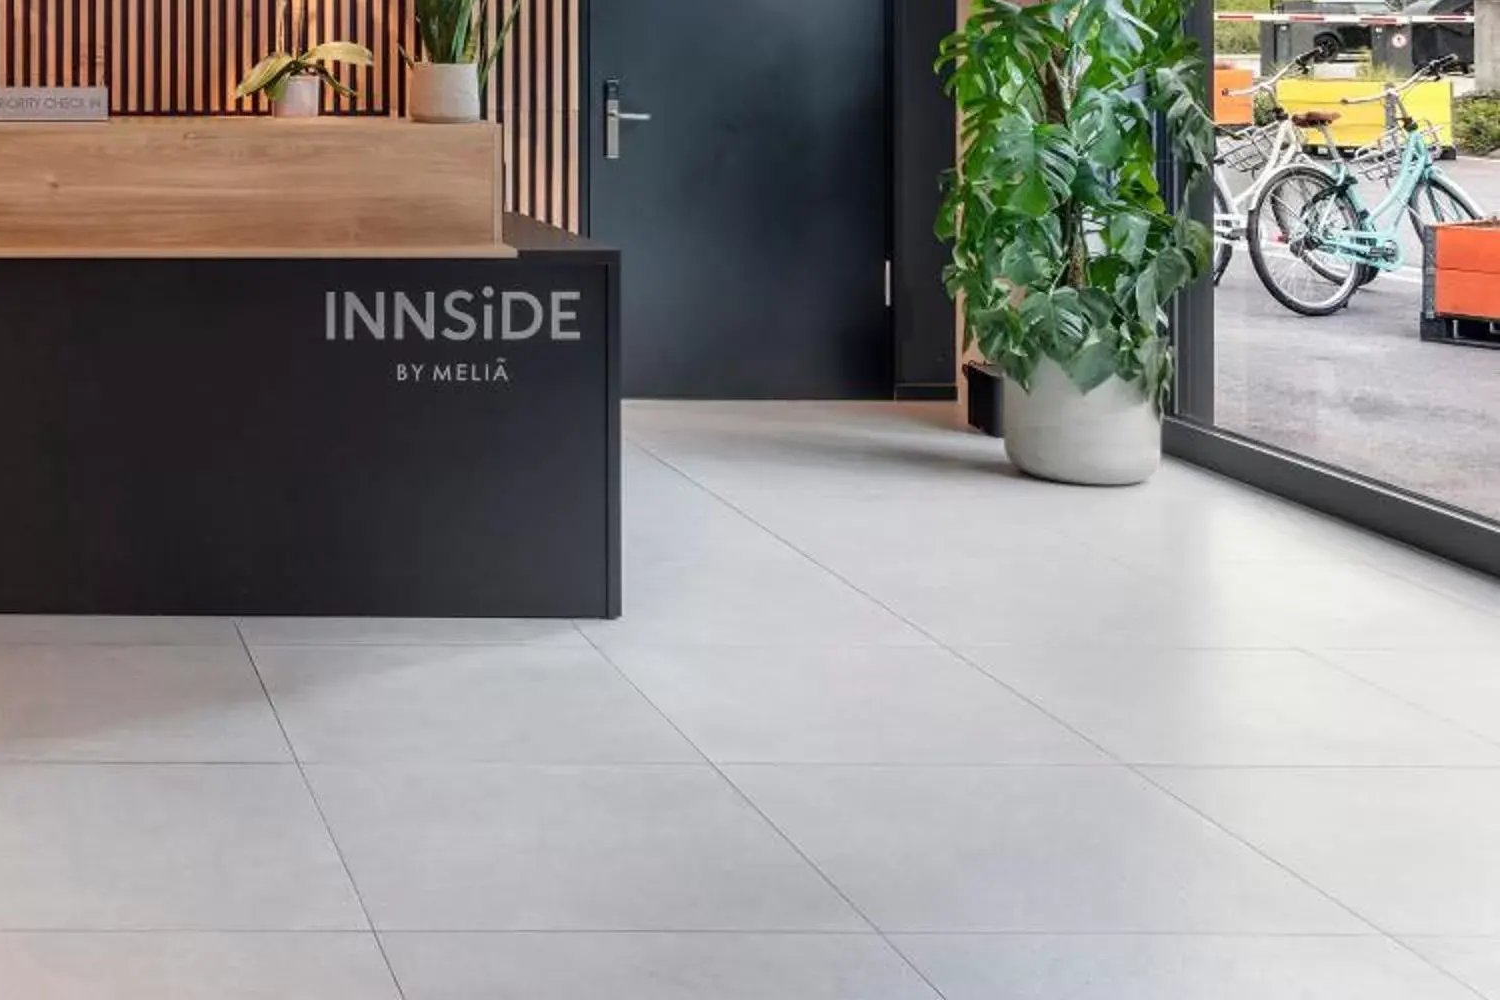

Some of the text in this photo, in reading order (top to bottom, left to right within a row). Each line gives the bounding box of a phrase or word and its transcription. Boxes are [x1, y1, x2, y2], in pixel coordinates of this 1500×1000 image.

[43, 97, 85, 109] CHECK
[90, 97, 102, 109] IN
[325, 286, 581, 340] INNSiDE
[396, 363, 425, 381] BY
